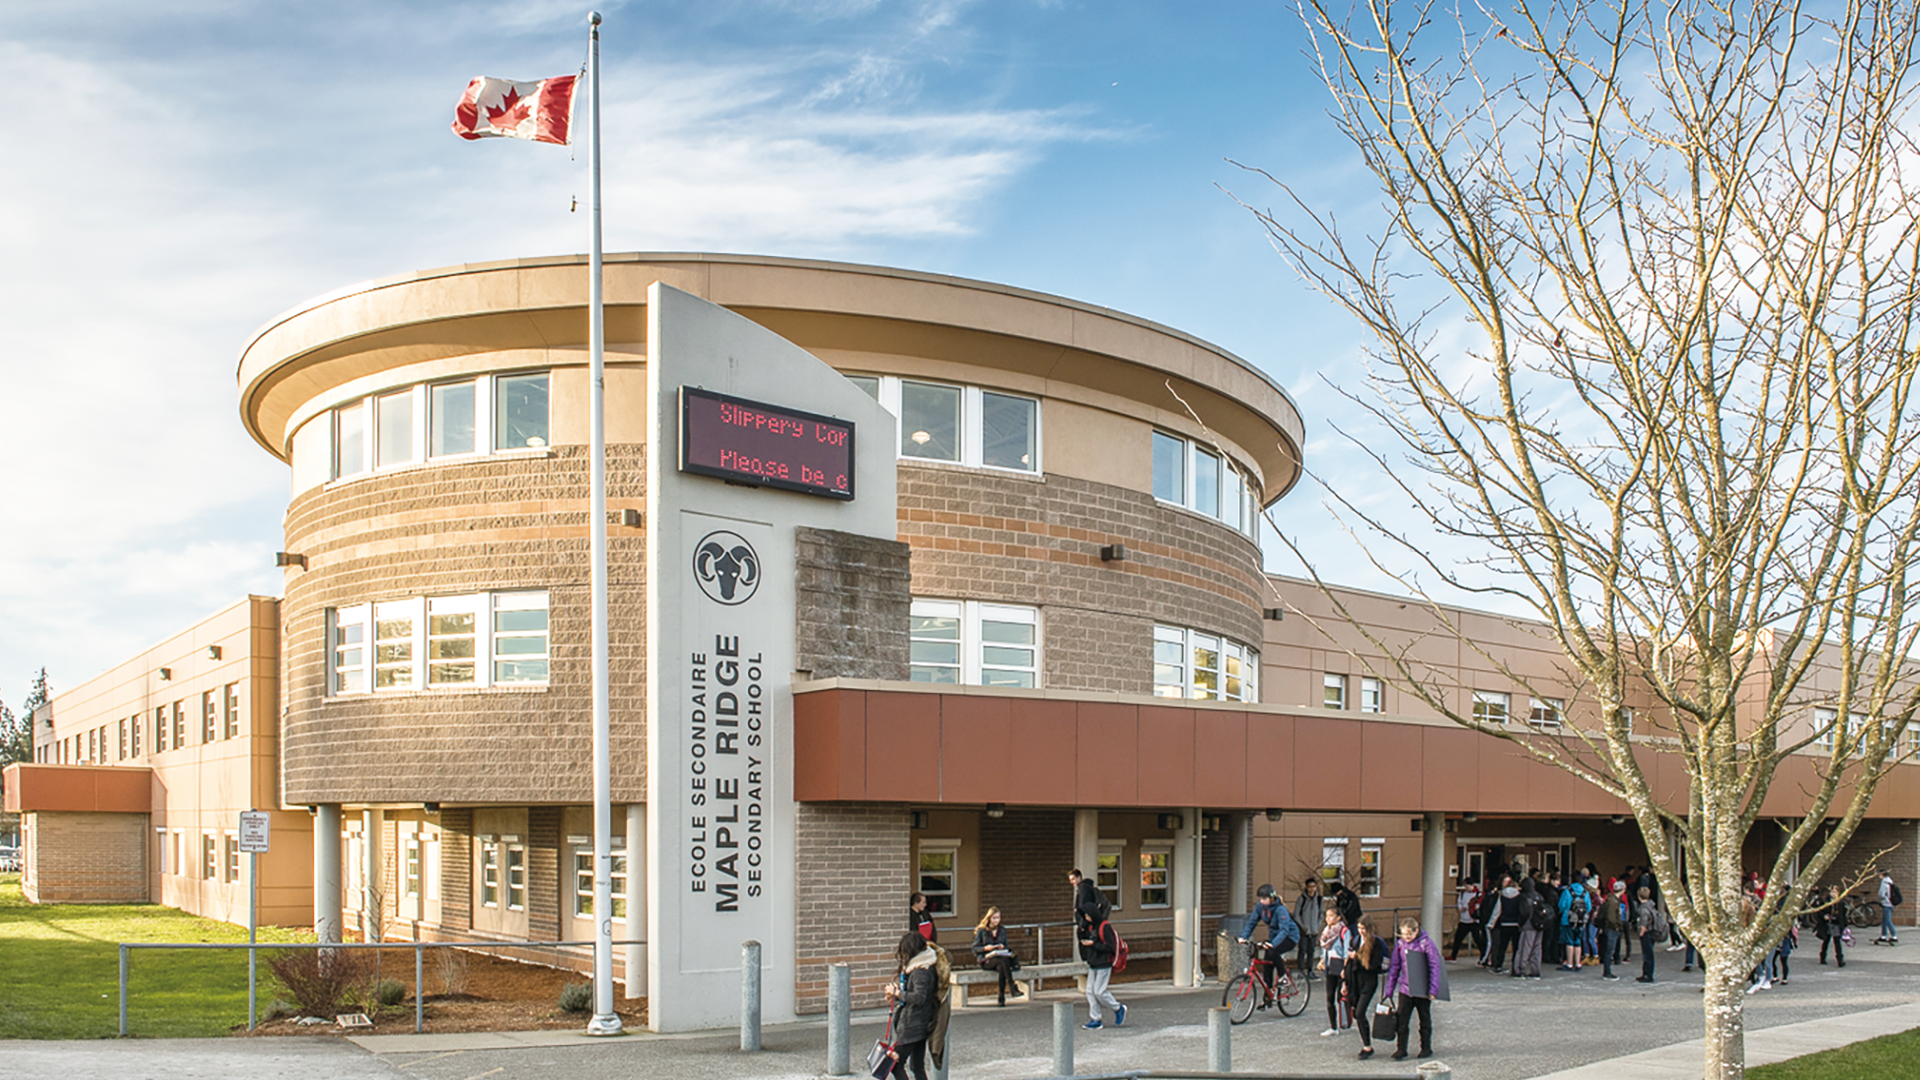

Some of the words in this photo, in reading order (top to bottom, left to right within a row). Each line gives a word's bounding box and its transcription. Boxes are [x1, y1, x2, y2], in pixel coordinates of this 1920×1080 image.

[720, 402, 804, 438] Slippery
[720, 449, 789, 479] Please
[802, 465, 824, 486] be
[692, 653, 706, 806] SECONDAIRE
[716, 635, 739, 755] RIDGE
[748, 652, 762, 747] SCHOOL
[692, 816, 706, 893] ECOLE
[716, 778, 739, 912] MAPLE
[748, 756, 762, 897] SECONDARY
